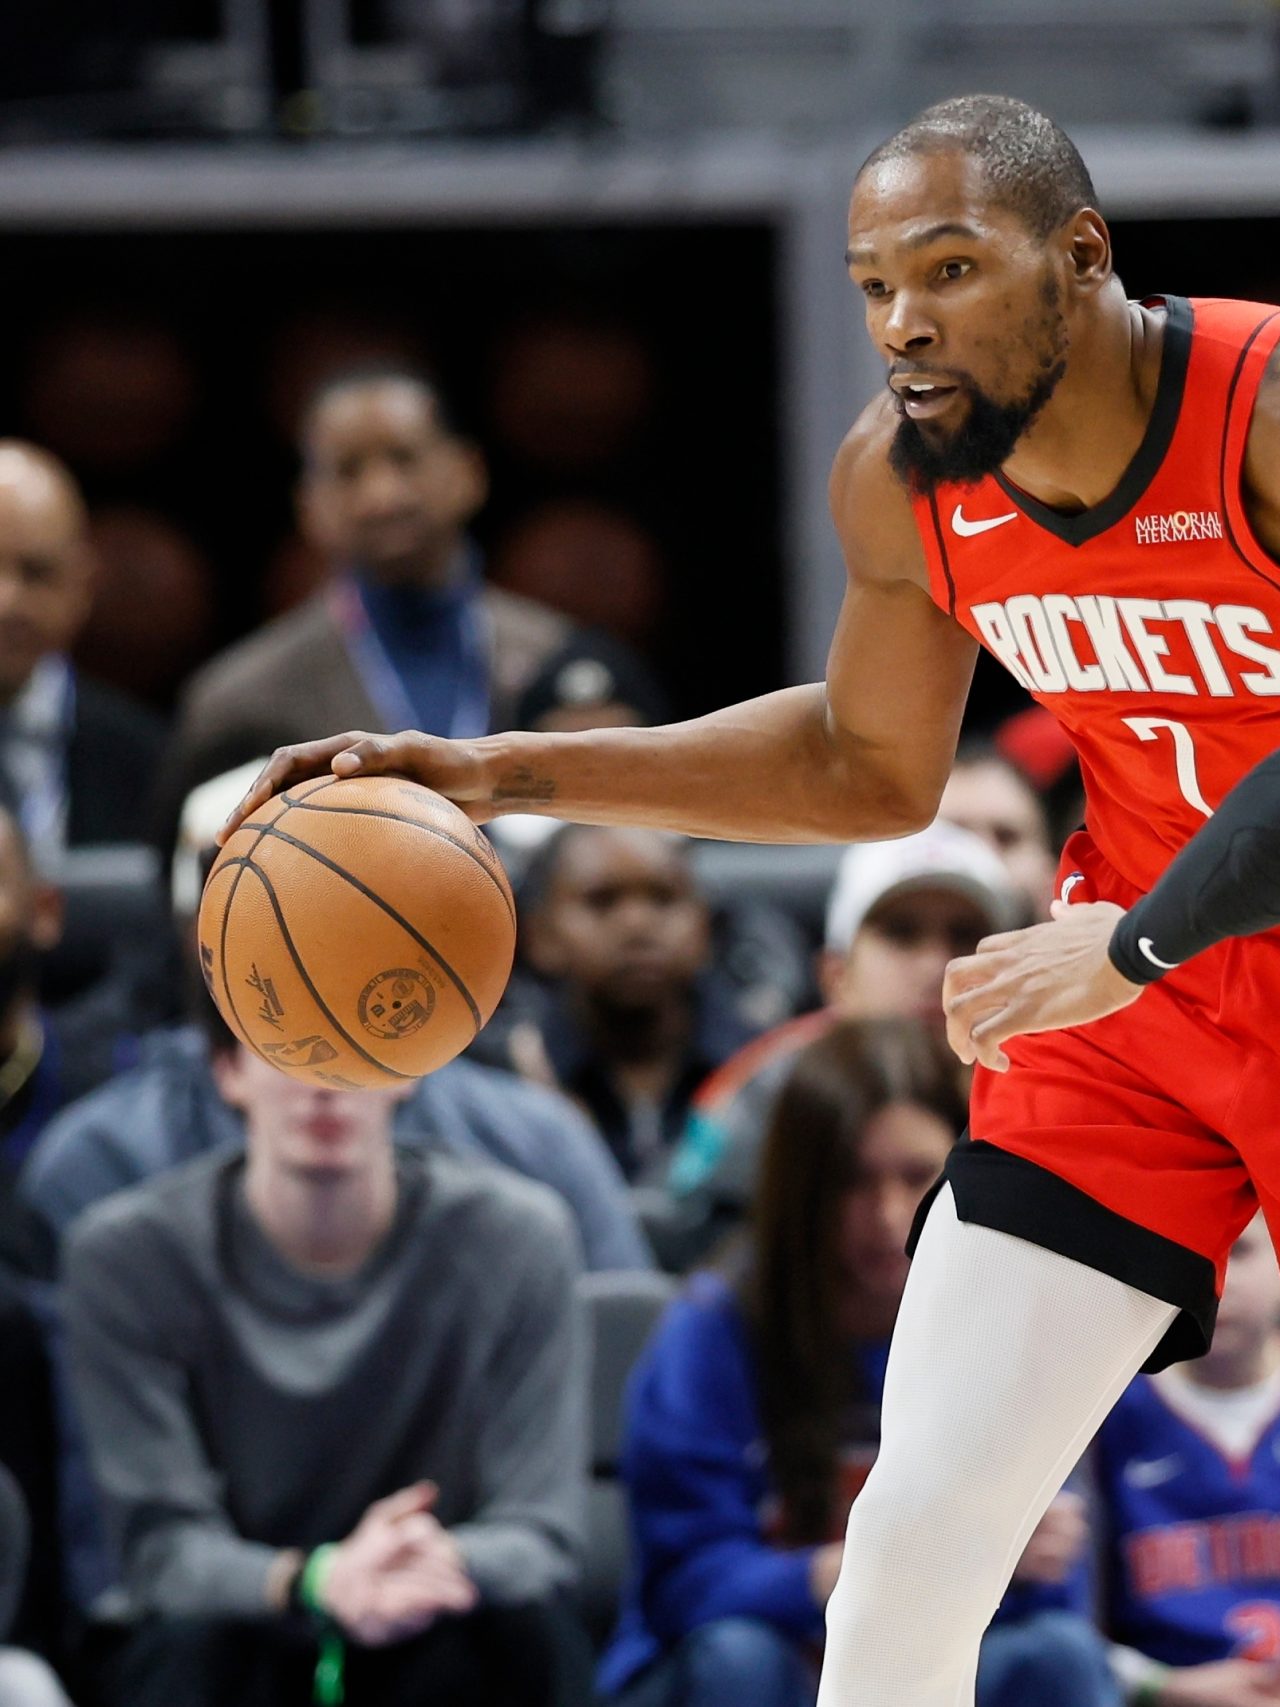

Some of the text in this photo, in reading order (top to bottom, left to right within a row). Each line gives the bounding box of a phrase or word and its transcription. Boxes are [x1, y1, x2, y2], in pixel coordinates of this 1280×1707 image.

[1135, 511, 1221, 532] MEMORIAL
[1136, 524, 1223, 545] HERMANN
[1121, 716, 1215, 818] 7
